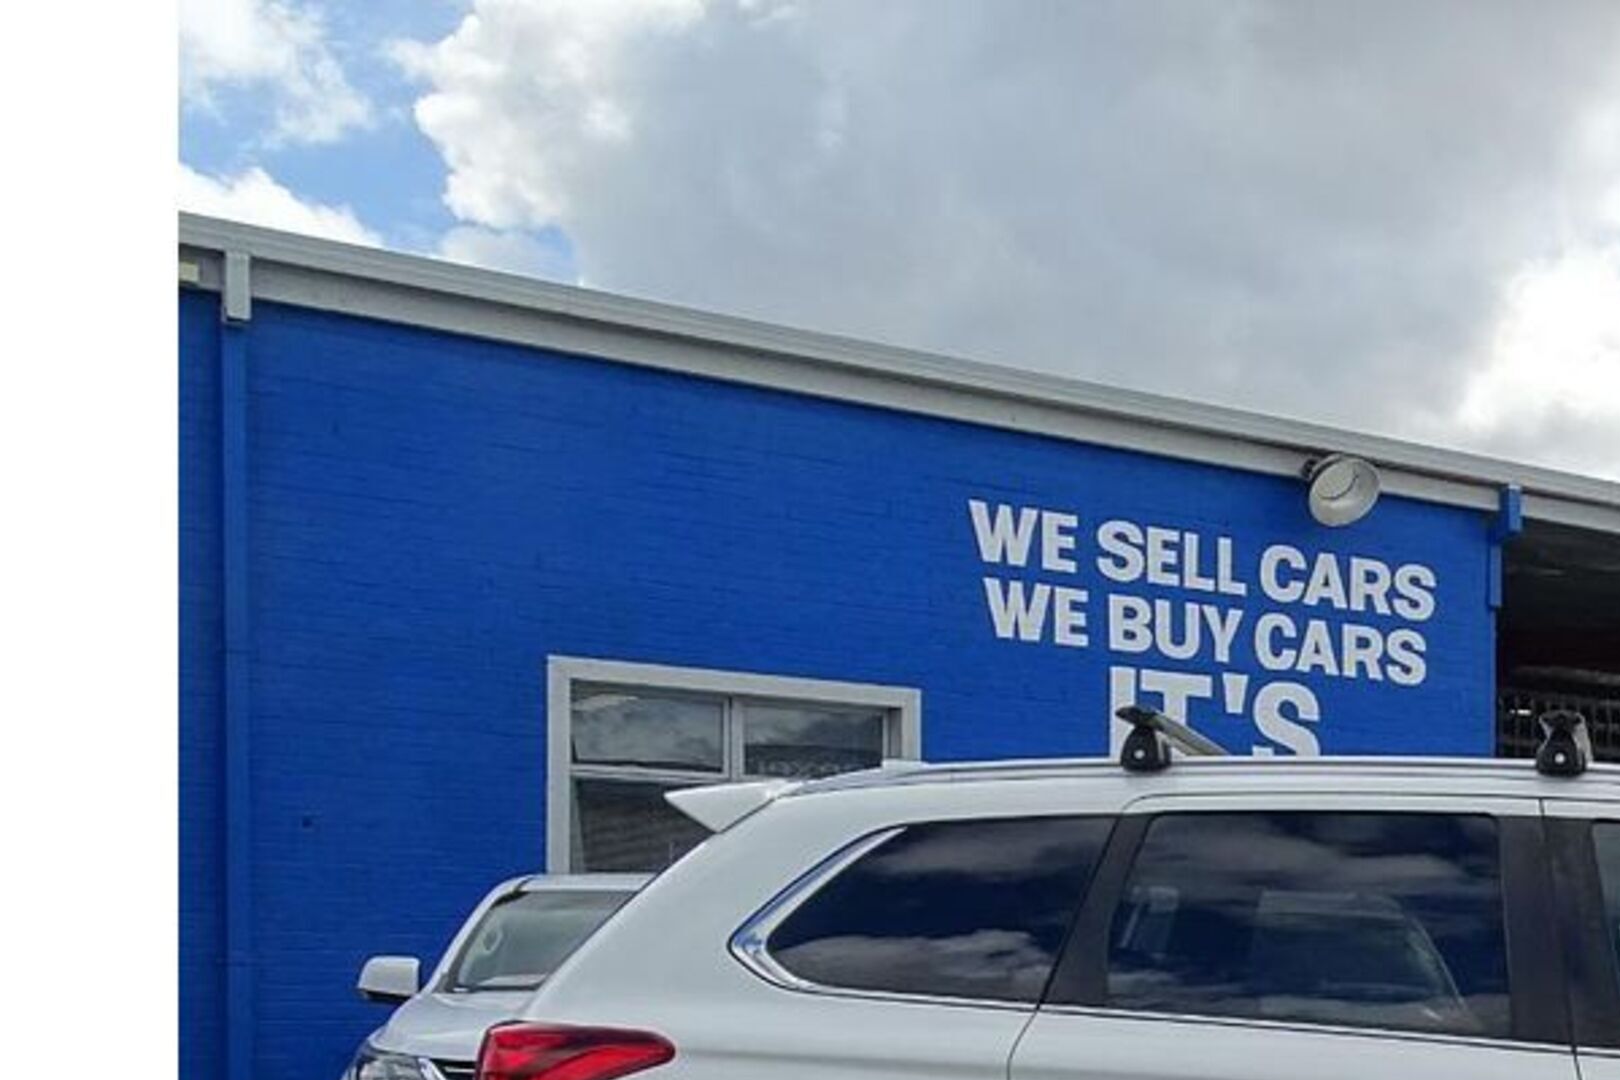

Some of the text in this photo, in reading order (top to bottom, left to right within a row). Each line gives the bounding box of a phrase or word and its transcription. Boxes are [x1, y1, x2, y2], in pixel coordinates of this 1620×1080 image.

[969, 500, 1437, 621] WE SELL CARS
[983, 577, 1426, 685] WE BUY CARS
[1108, 666, 1321, 758] IT'S
